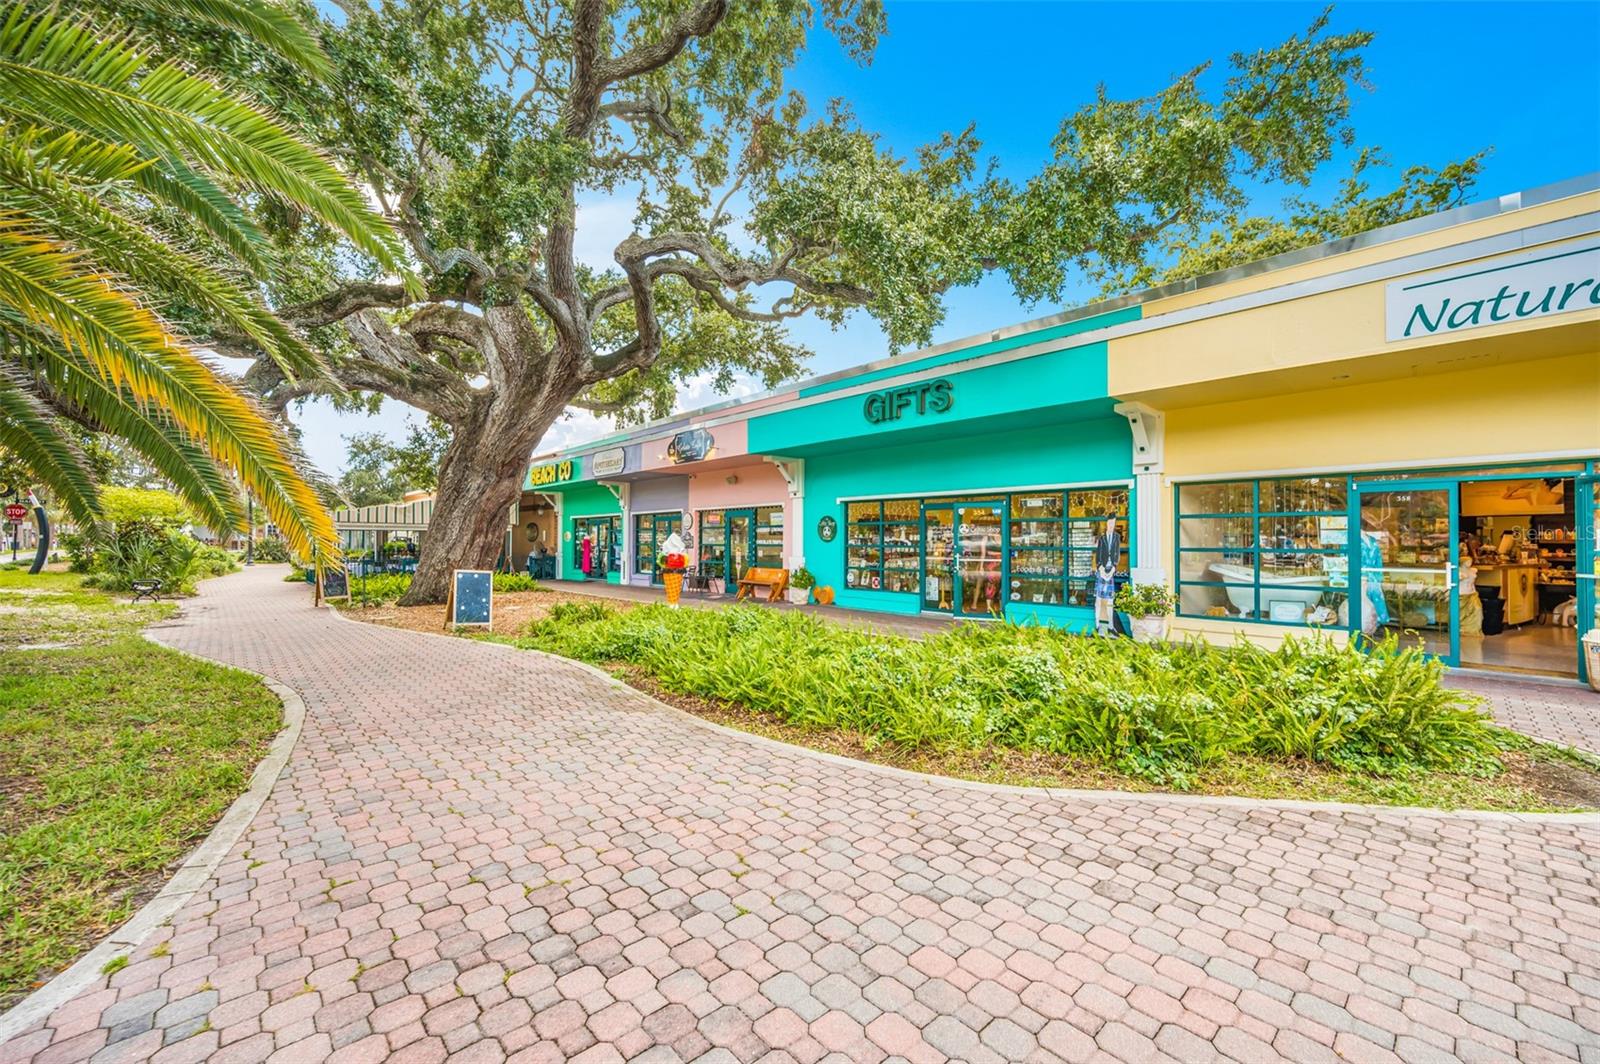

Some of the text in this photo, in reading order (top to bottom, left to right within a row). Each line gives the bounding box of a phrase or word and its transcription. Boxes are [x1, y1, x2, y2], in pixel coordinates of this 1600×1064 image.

[863, 379, 954, 425] GIFTS
[531, 460, 573, 486] BEACH CO
